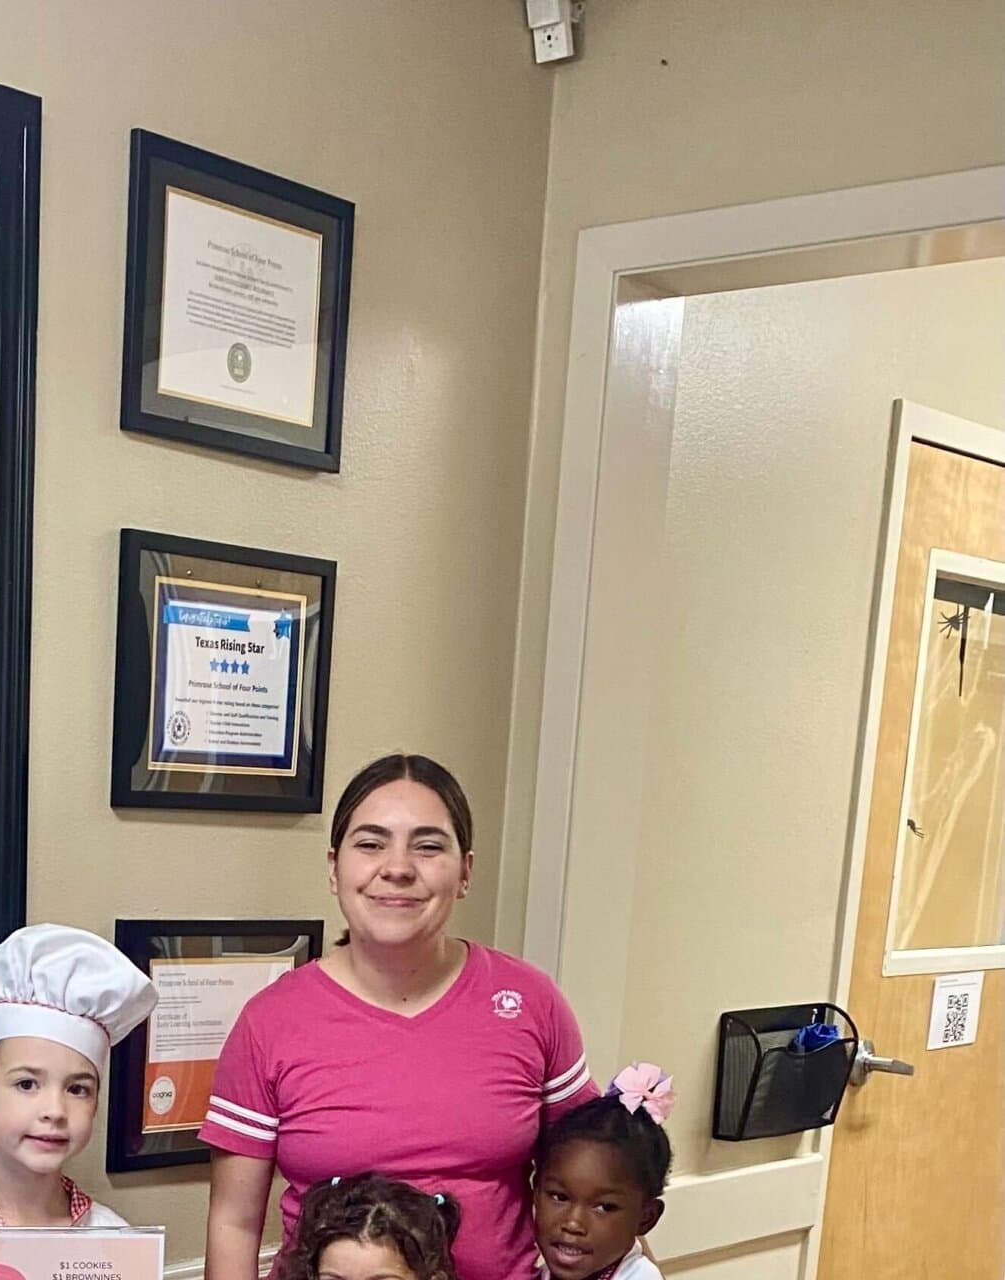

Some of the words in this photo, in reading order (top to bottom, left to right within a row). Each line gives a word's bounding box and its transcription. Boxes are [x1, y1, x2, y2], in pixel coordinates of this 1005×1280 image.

[195, 636, 219, 649] Texas
[220, 639, 246, 655] Rising
[248, 642, 265, 654] Star
[214, 682, 231, 690] School
[59, 1261, 70, 1270] $1
[72, 1261, 113, 1270] COOKIES
[52, 1273, 63, 1280] $1
[65, 1273, 122, 1280] BROWNINES
